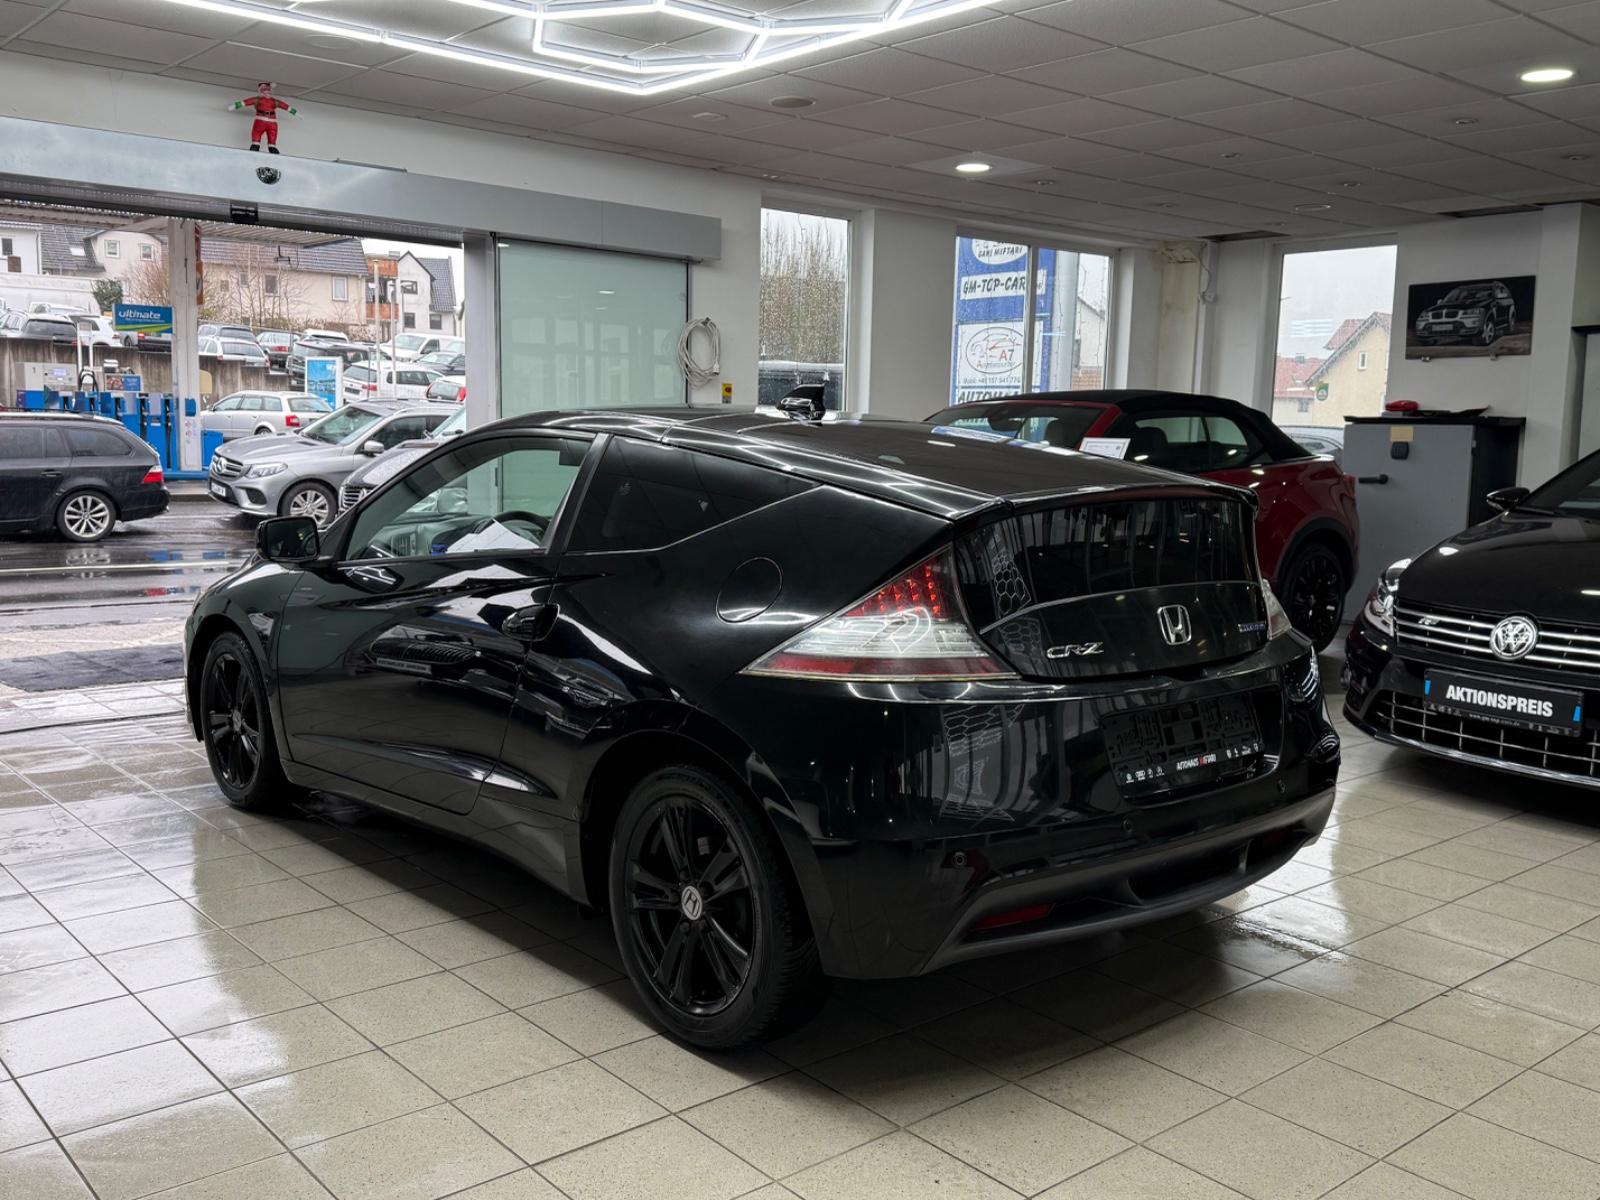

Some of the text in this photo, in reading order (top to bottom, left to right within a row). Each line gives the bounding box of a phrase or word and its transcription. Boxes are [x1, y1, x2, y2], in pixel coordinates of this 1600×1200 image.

[963, 276, 1042, 295] GM-TOP-CAR
[118, 309, 161, 319] ultimate
[1445, 684, 1554, 718] AKTIONSPREIS
